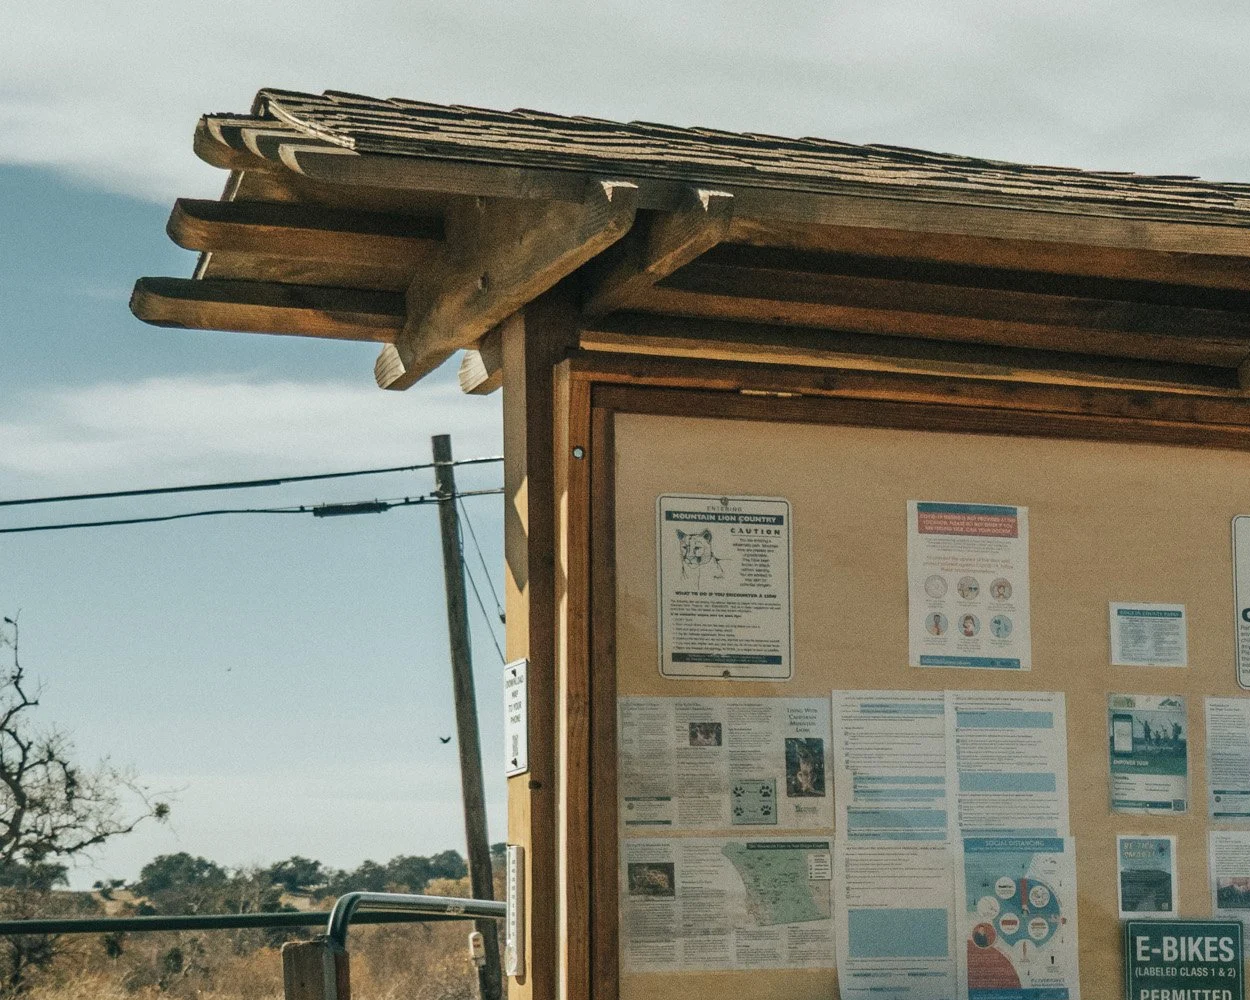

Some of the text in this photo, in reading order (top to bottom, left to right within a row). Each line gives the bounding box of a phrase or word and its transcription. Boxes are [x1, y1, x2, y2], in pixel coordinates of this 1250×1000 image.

[505, 675, 524, 688] DOWNLOAD
[514, 701, 522, 710] YOUR
[510, 714, 521, 724] PHONE
[1136, 936, 1234, 962] E-BIKES
[1135, 967, 1236, 978] (LABELED CLASS 1 & 2)
